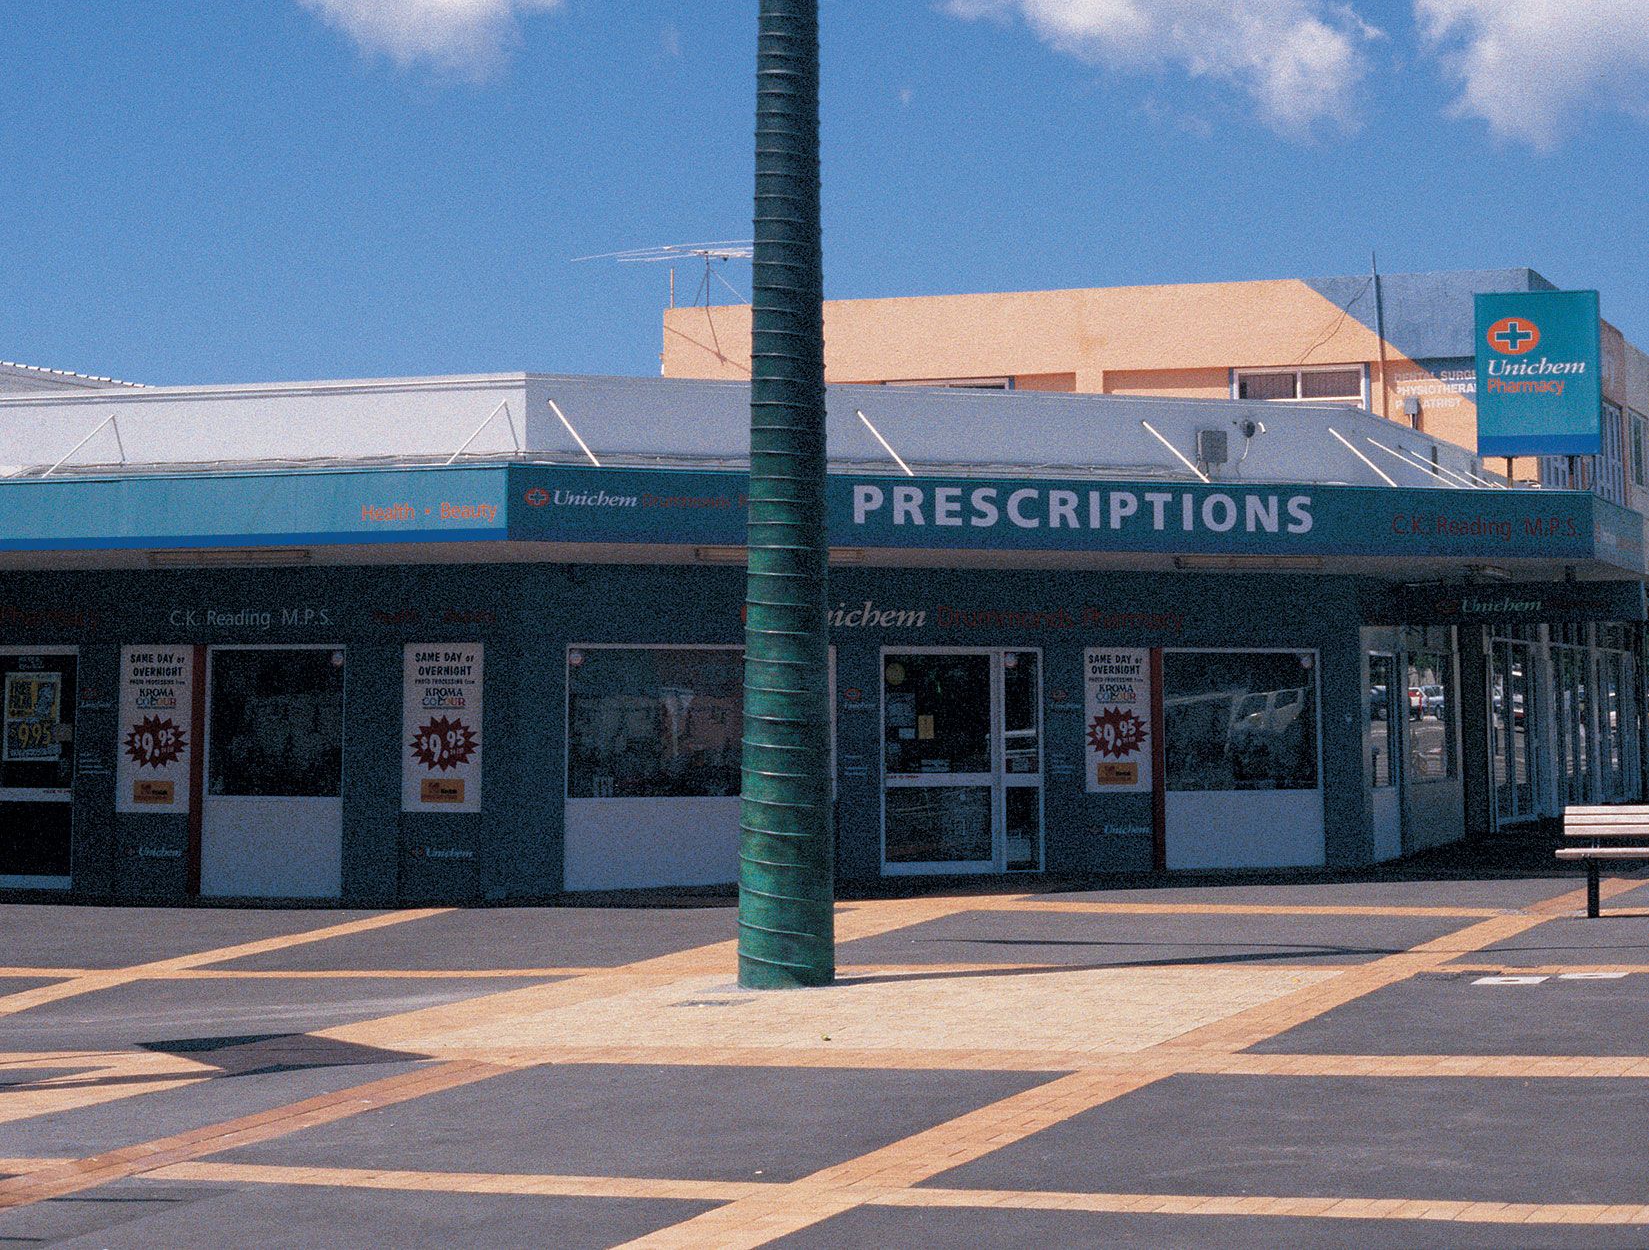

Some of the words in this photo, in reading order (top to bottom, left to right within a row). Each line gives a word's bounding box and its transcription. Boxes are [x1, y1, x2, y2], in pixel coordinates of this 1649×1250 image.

[1488, 357, 1586, 376] Unichem
[1487, 377, 1565, 396] Pharmacy
[1395, 397, 1461, 409] PATRIST
[553, 490, 638, 508] Unichem
[361, 502, 415, 521] Health
[440, 501, 497, 523] Beauty
[853, 485, 1313, 534] PRESCRIPTIONS
[1436, 515, 1512, 542] Reading
[827, 601, 926, 627] ichem
[1462, 599, 1542, 613] Unichem
[206, 609, 271, 630] Reading
[281, 608, 334, 626] M.P.S.
[130, 654, 154, 664] SAME
[157, 653, 175, 663] DAY
[415, 652, 440, 662] SAME
[444, 652, 463, 662] DAY
[1089, 655, 1112, 664] SAME
[1115, 655, 1132, 664] DAY
[133, 668, 182, 677] OVERNIGHT
[418, 666, 471, 676] OVERNIGHT
[1091, 665, 1141, 675] OVERNIGHT
